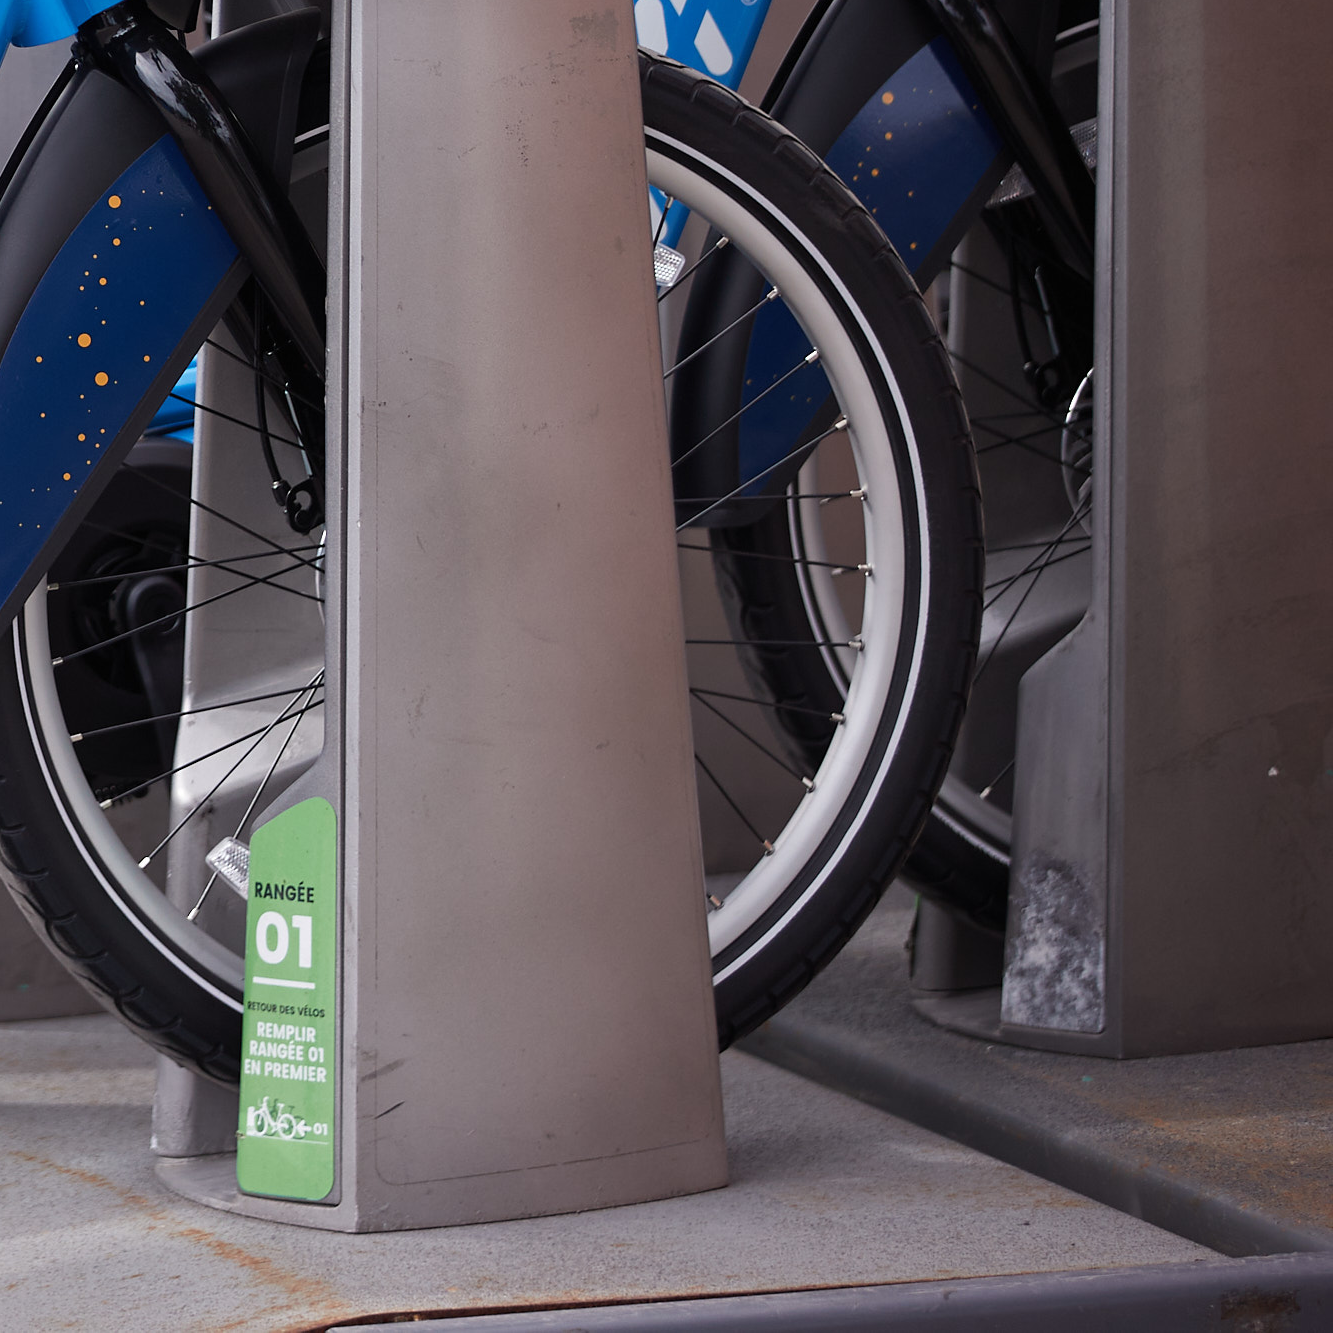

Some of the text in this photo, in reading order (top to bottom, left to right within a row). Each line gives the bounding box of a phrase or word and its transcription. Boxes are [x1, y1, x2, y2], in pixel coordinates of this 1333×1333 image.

[254, 881, 315, 903] RANGÉE
[255, 910, 312, 969] 01
[247, 1000, 326, 1018] RETOUR DES VÉLOS
[256, 1021, 317, 1043] REMPLIR
[249, 1039, 325, 1063] RANGÉE 01
[244, 1058, 328, 1083] EN PREMIER
[313, 1122, 329, 1136] 01
